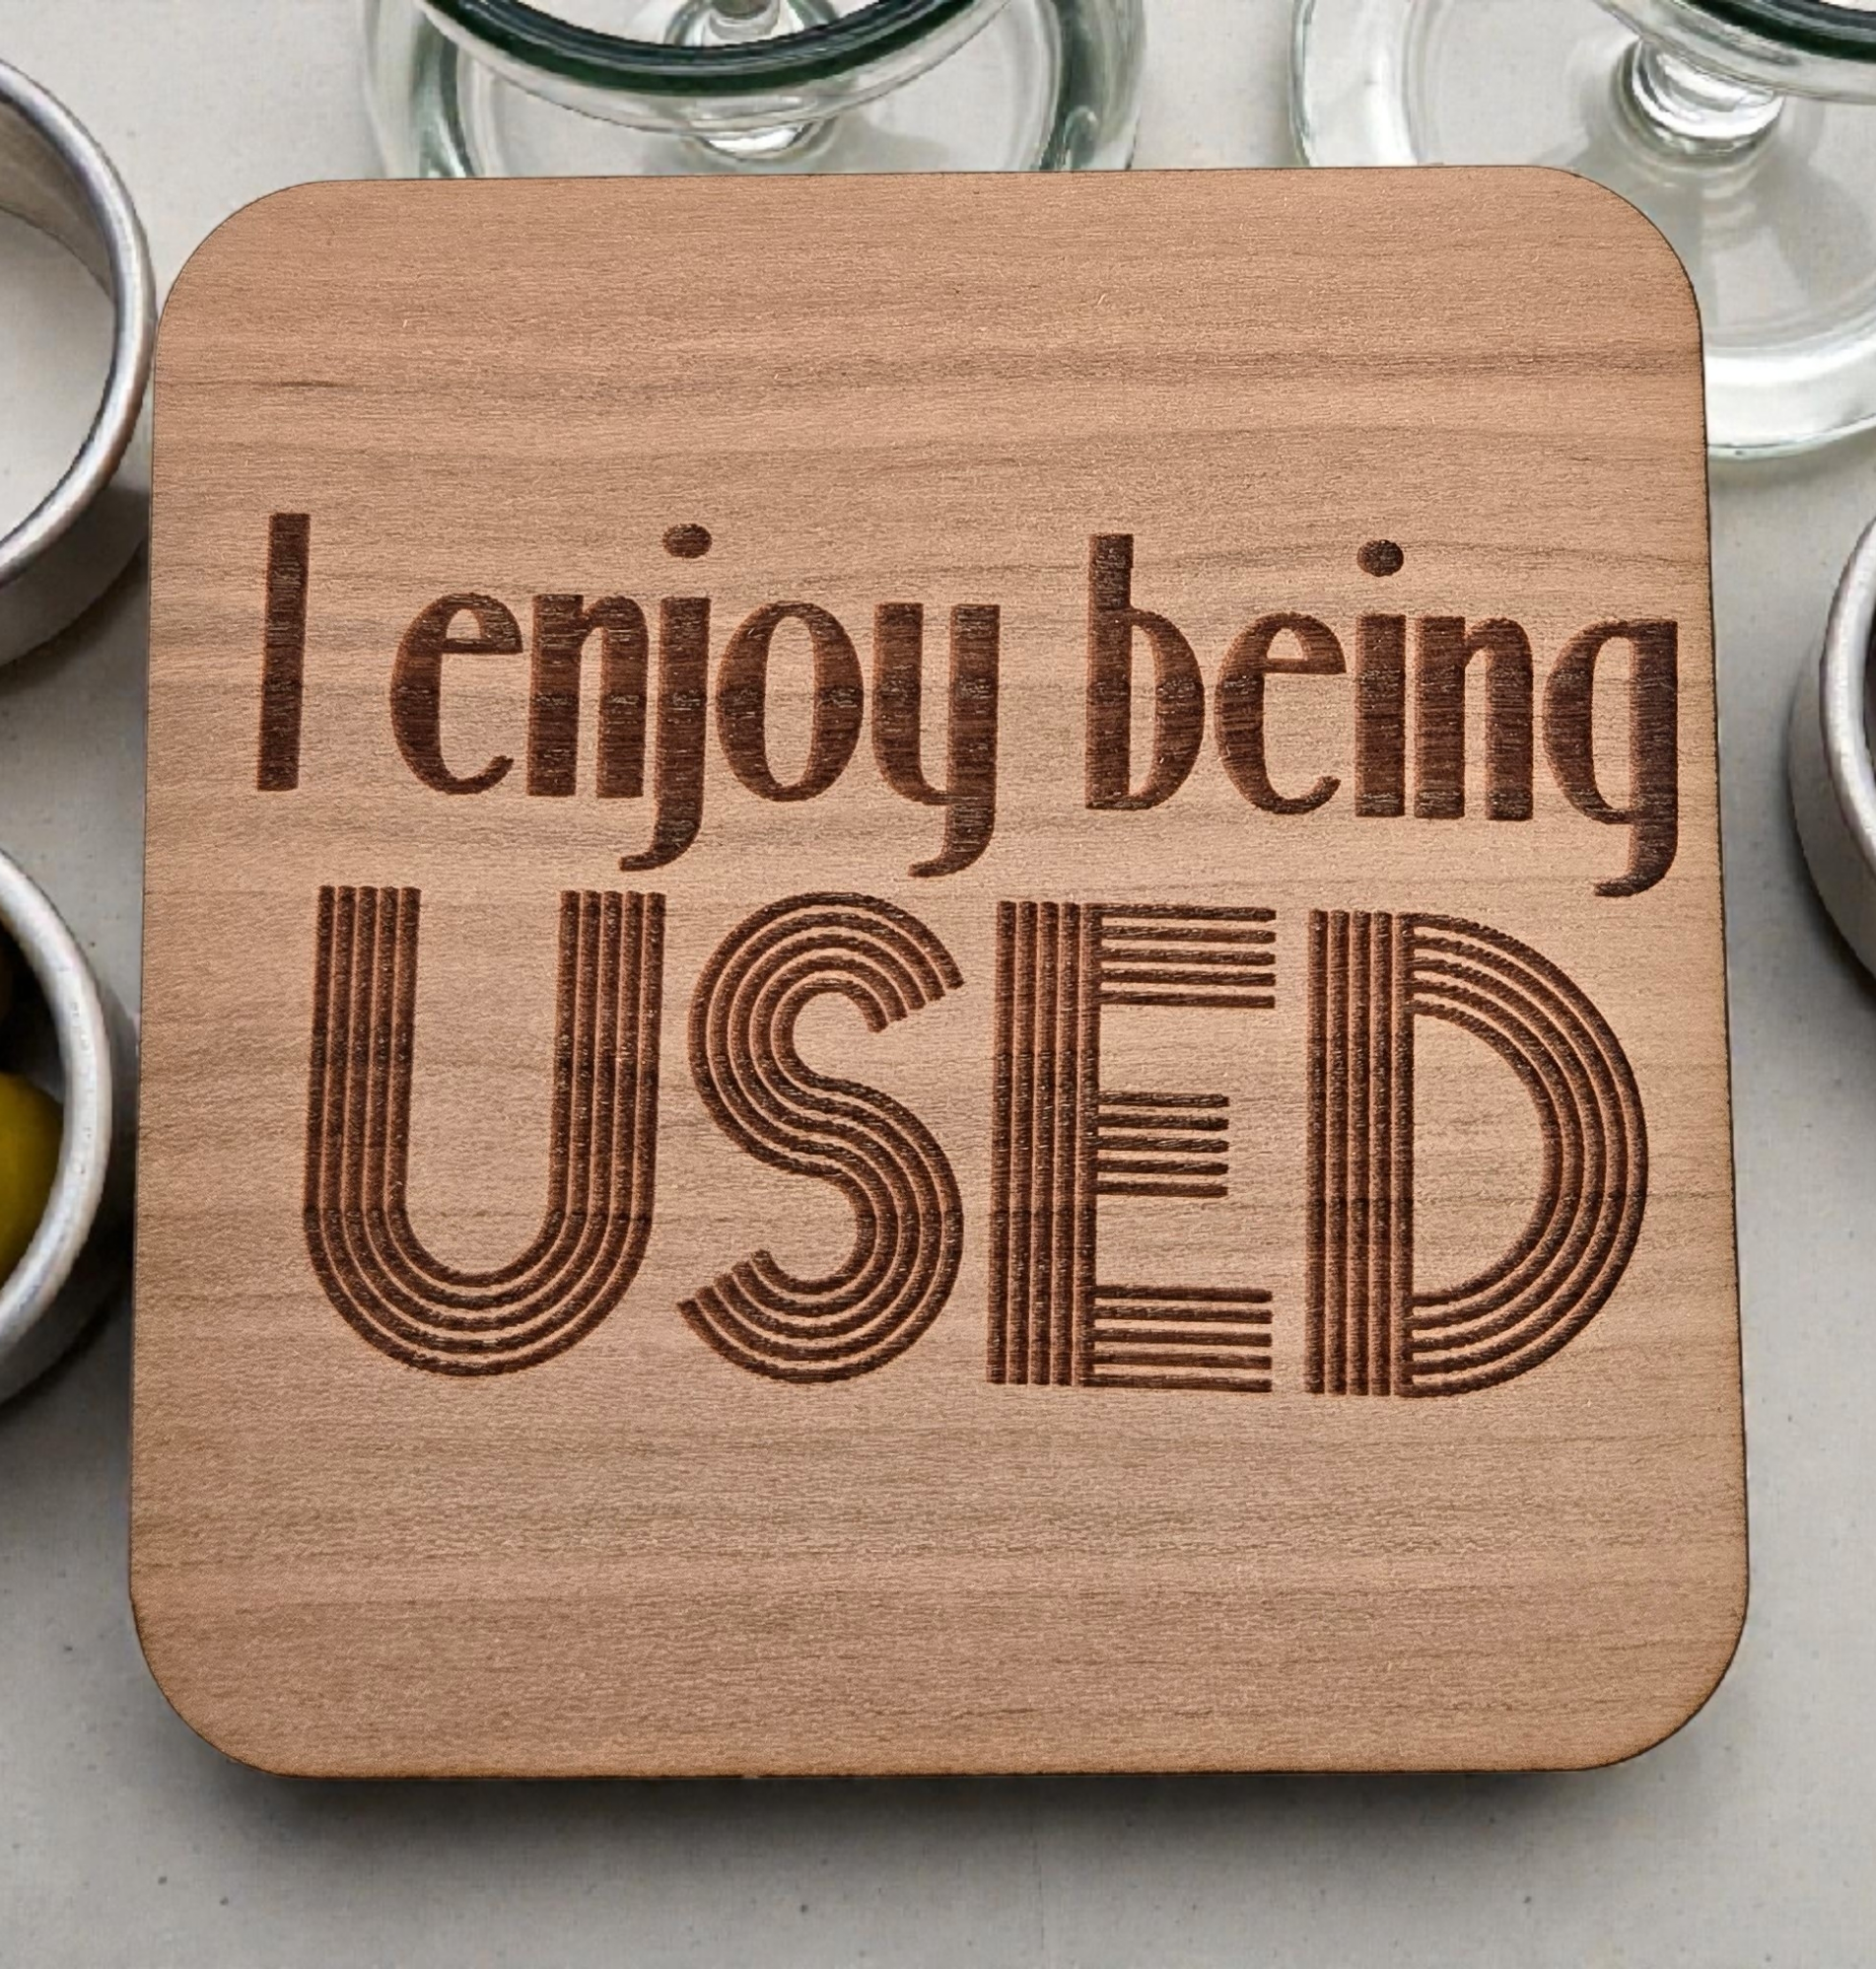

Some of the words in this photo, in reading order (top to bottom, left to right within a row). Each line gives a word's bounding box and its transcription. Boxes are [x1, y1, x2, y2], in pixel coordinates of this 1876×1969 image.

[257, 513, 311, 791] I
[389, 524, 1001, 878] enjoy
[1086, 533, 1679, 897] being
[304, 885, 1648, 1397] USED
